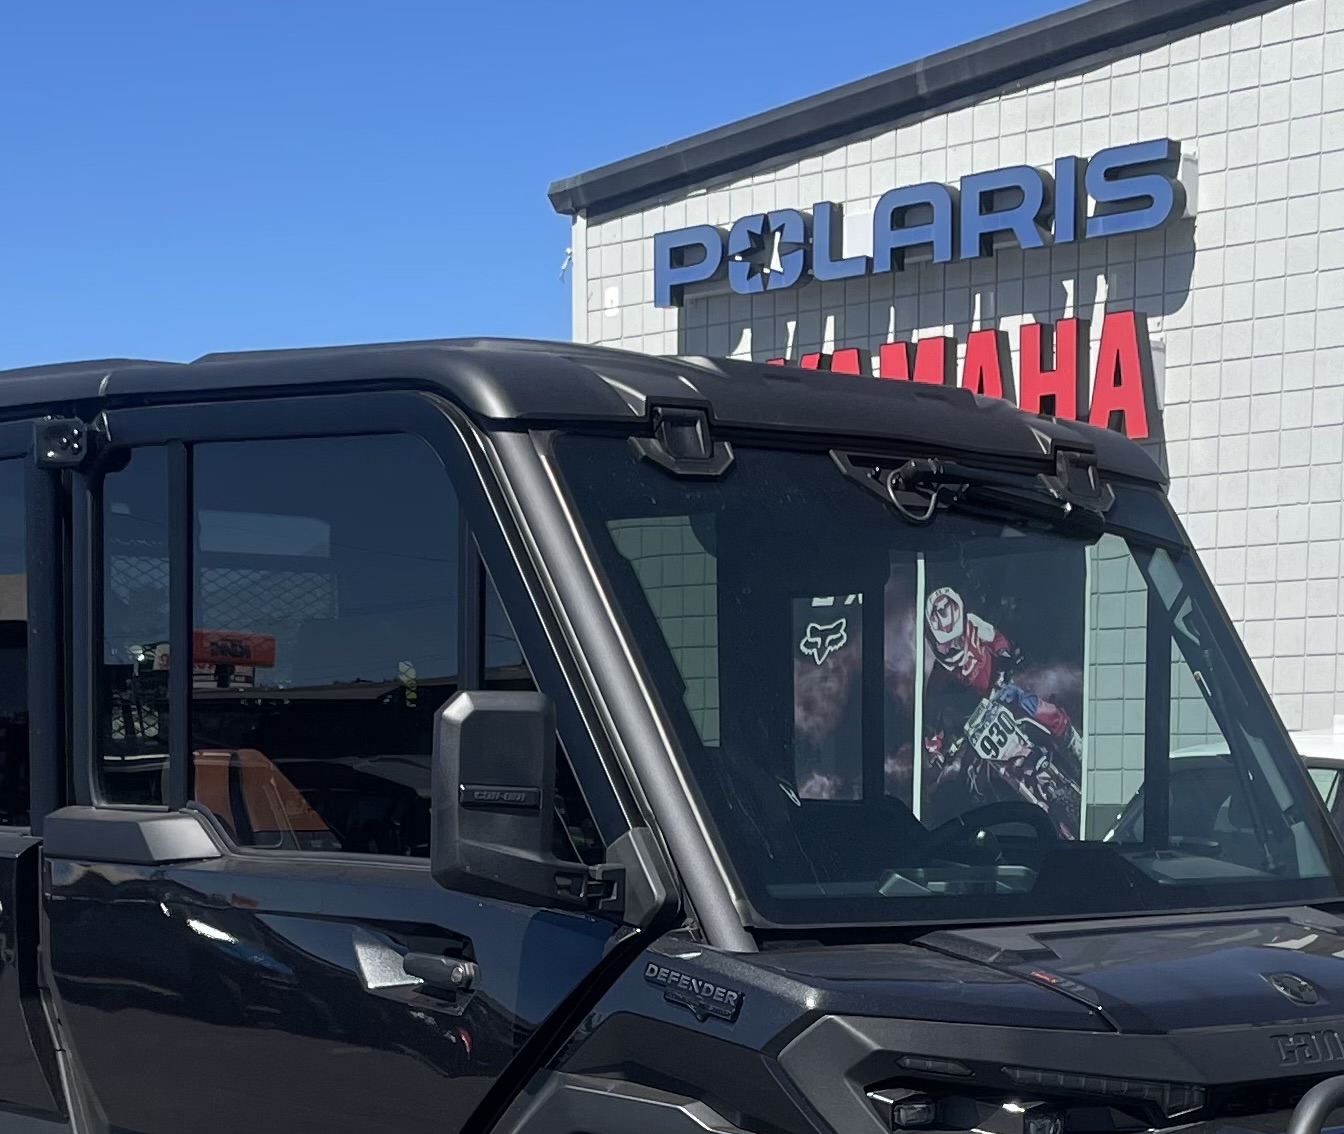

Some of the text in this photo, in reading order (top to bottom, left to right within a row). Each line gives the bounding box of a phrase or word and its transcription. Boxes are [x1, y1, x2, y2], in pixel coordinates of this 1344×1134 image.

[653, 138, 1183, 308] POLARIS
[766, 310, 1148, 439] AHA
[979, 710, 1016, 759] 930
[644, 962, 739, 1007] DEFENDER
